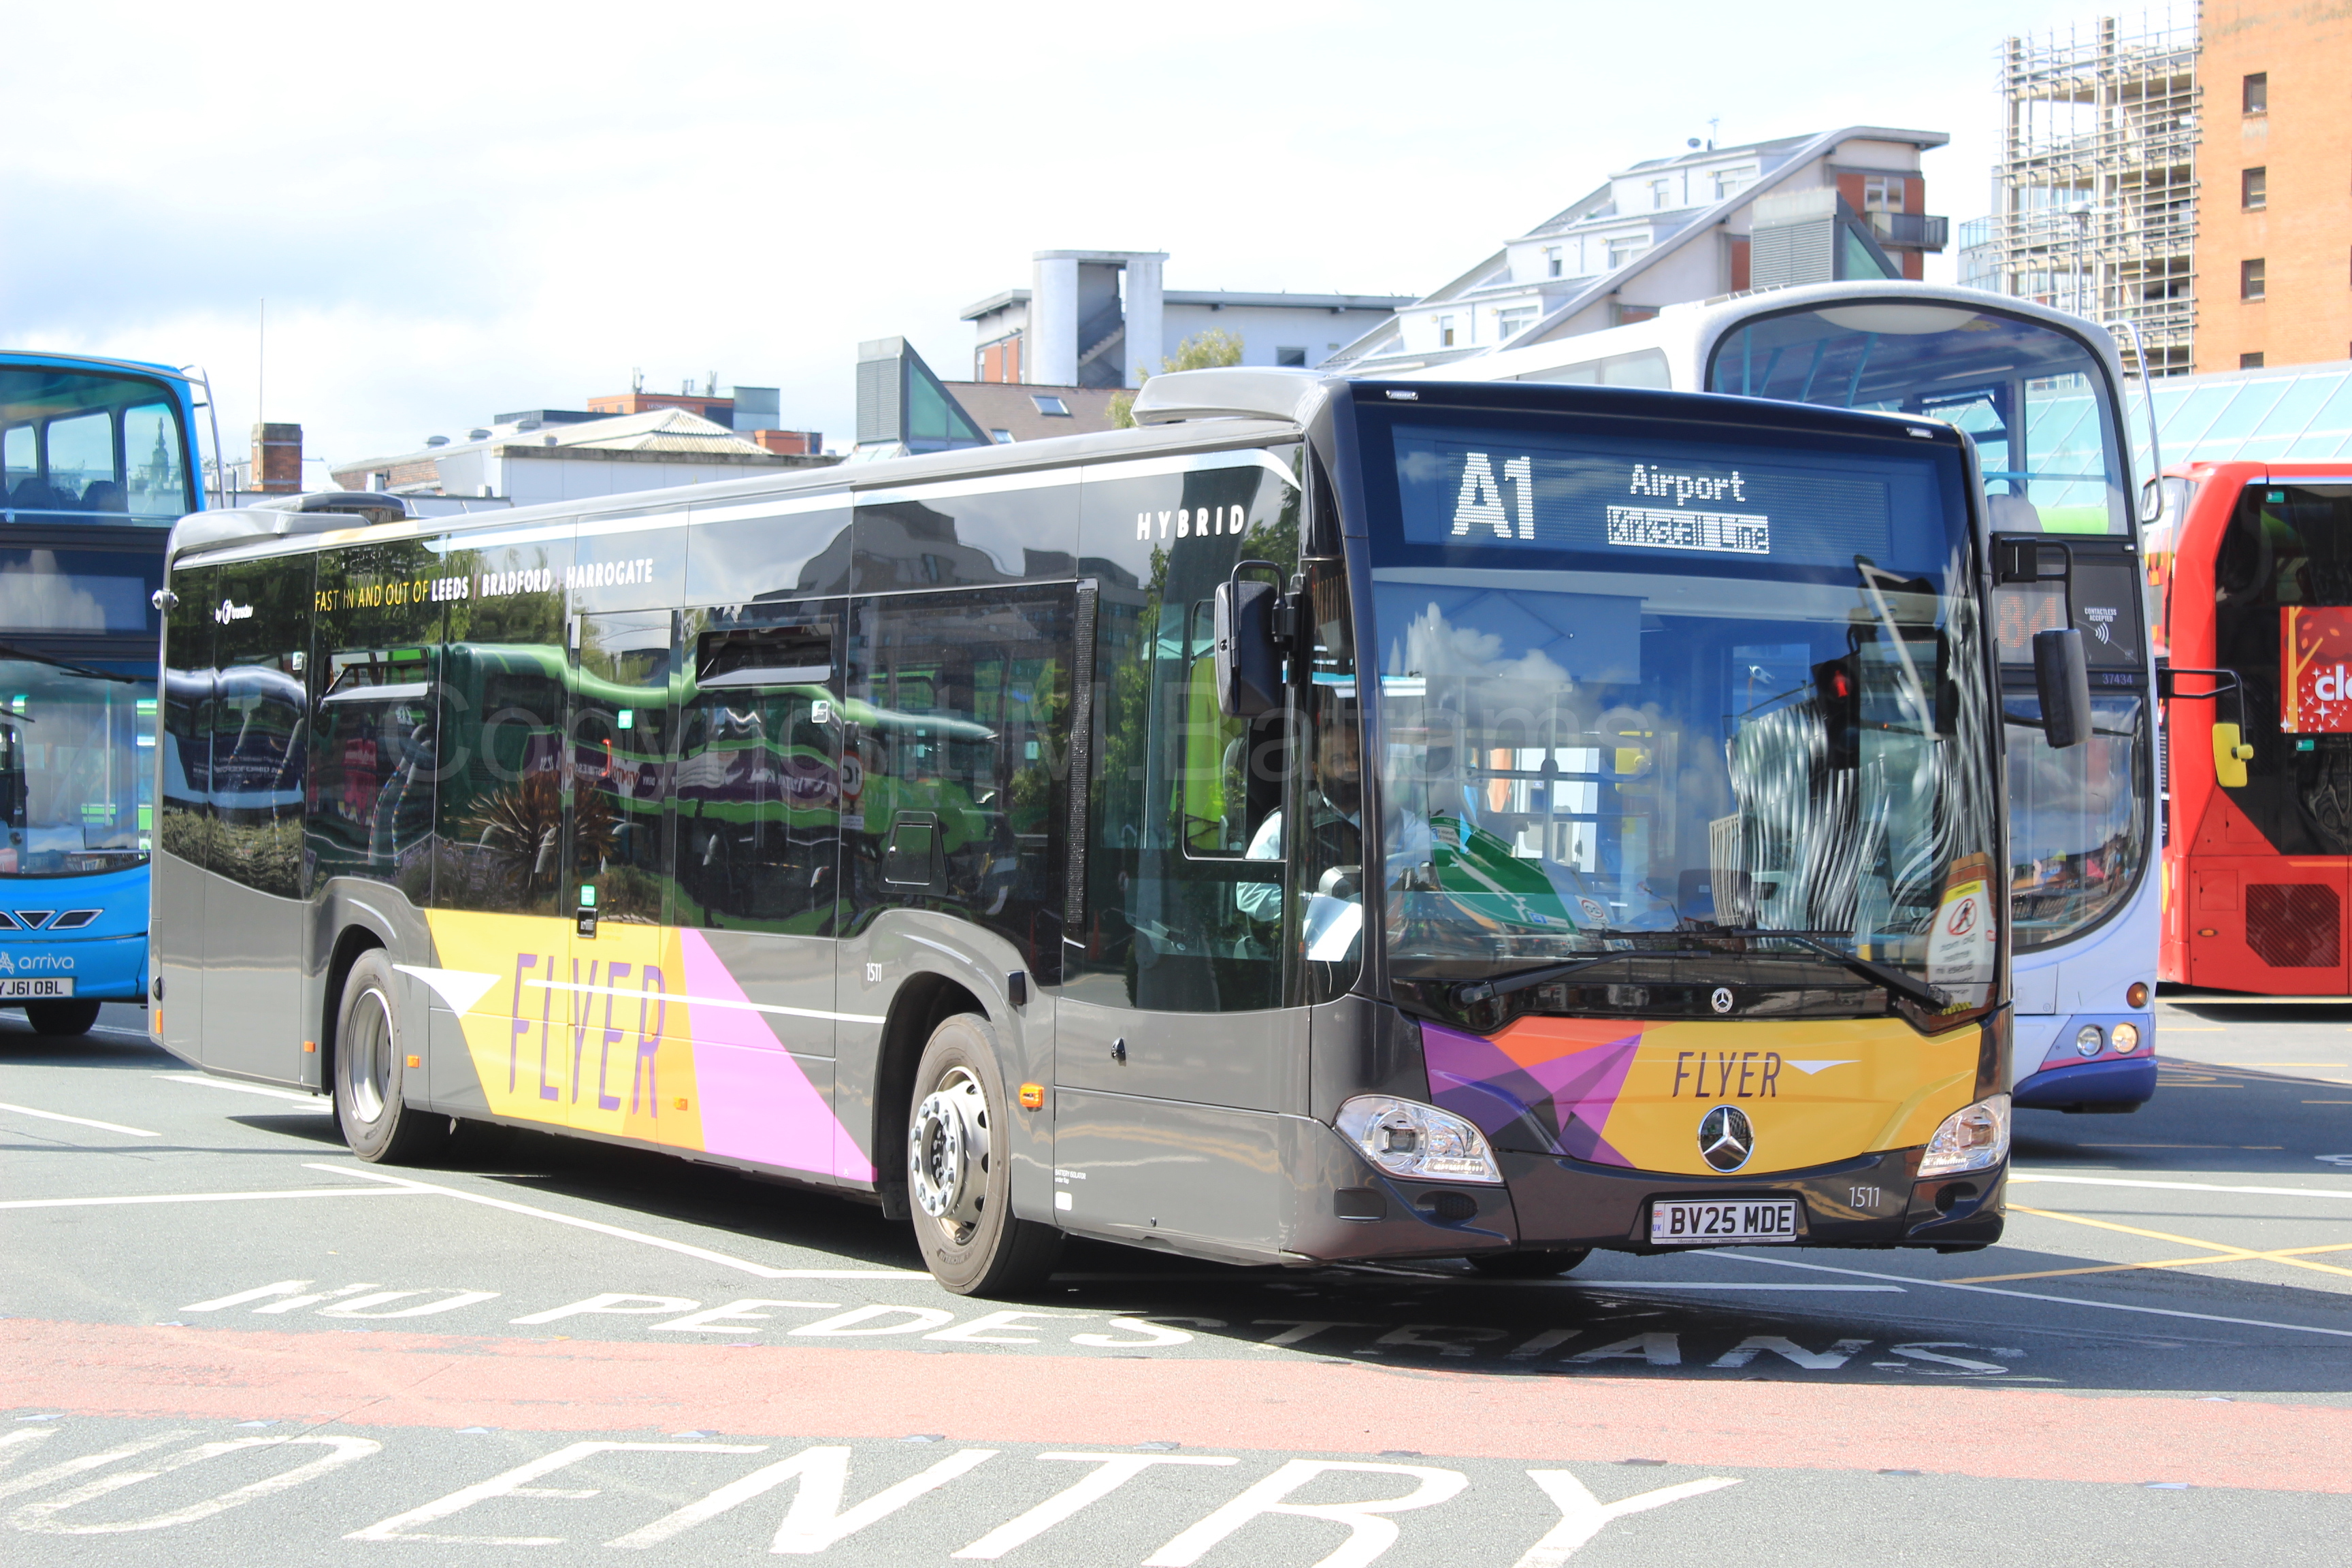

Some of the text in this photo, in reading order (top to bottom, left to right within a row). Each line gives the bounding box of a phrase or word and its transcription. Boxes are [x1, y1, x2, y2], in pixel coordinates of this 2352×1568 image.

[1451, 452, 1535, 540] A1
[1630, 463, 1746, 506] Airport
[1137, 504, 1245, 541] HYBRID
[1610, 508, 1769, 551] Kirkstall Line
[314, 557, 654, 612] FAST IN AND OUT OF LEEDS BRADFORD HARROGATE
[215, 604, 254, 623] by transdev
[1998, 596, 2056, 648] 84
[2084, 607, 2117, 616] CONTACTLESS
[2089, 615, 2114, 623] ACCEPTED
[2102, 673, 2134, 685] 37434
[18, 954, 74, 969] arriva
[866, 962, 882, 983] 1511
[34, 981, 63, 995] OBL
[509, 953, 666, 1119] FLYER
[1672, 1051, 1781, 1098] FLYER
[1055, 1169, 1087, 1180] BATTERY ISOLATOR
[1848, 1186, 1880, 1208] 1511
[1652, 1224, 1662, 1232] UK
[1670, 1205, 1793, 1235] BV25 MDE
[178, 1279, 2028, 1376] NO PEDESTRIANS
[342, 1439, 1746, 1568] ENTRY
